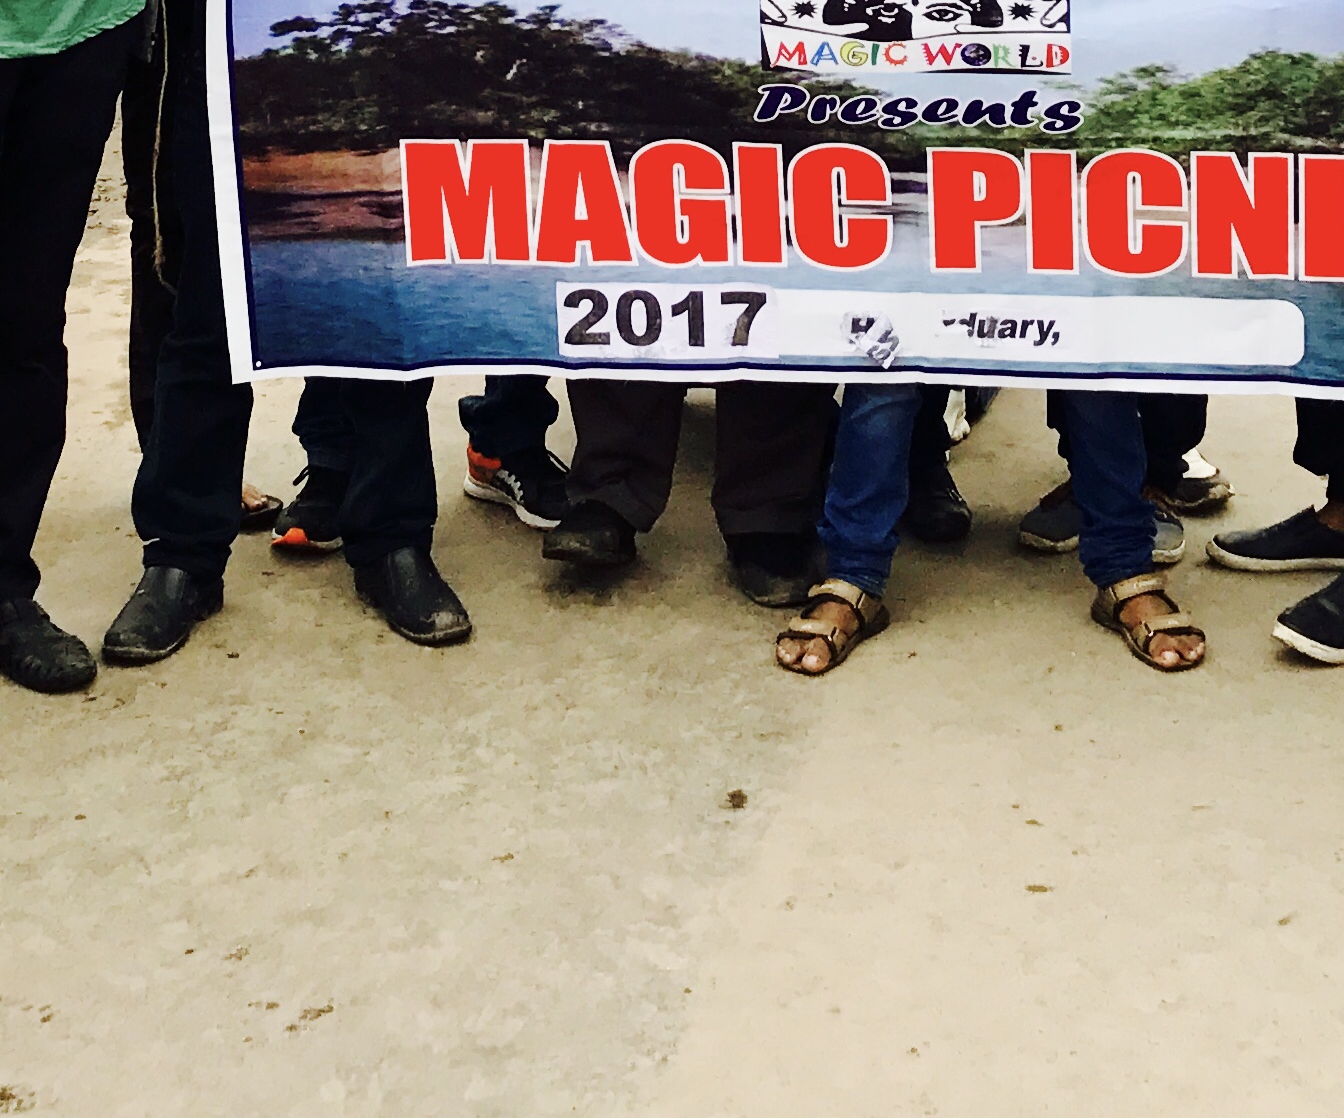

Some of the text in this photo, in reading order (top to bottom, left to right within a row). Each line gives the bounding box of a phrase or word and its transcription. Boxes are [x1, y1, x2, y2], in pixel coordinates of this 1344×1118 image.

[770, 40, 1070, 69] MAGIC WORLD
[754, 83, 1085, 135] Presents
[400, 136, 894, 272] MAGIC
[563, 288, 768, 348] 2017
